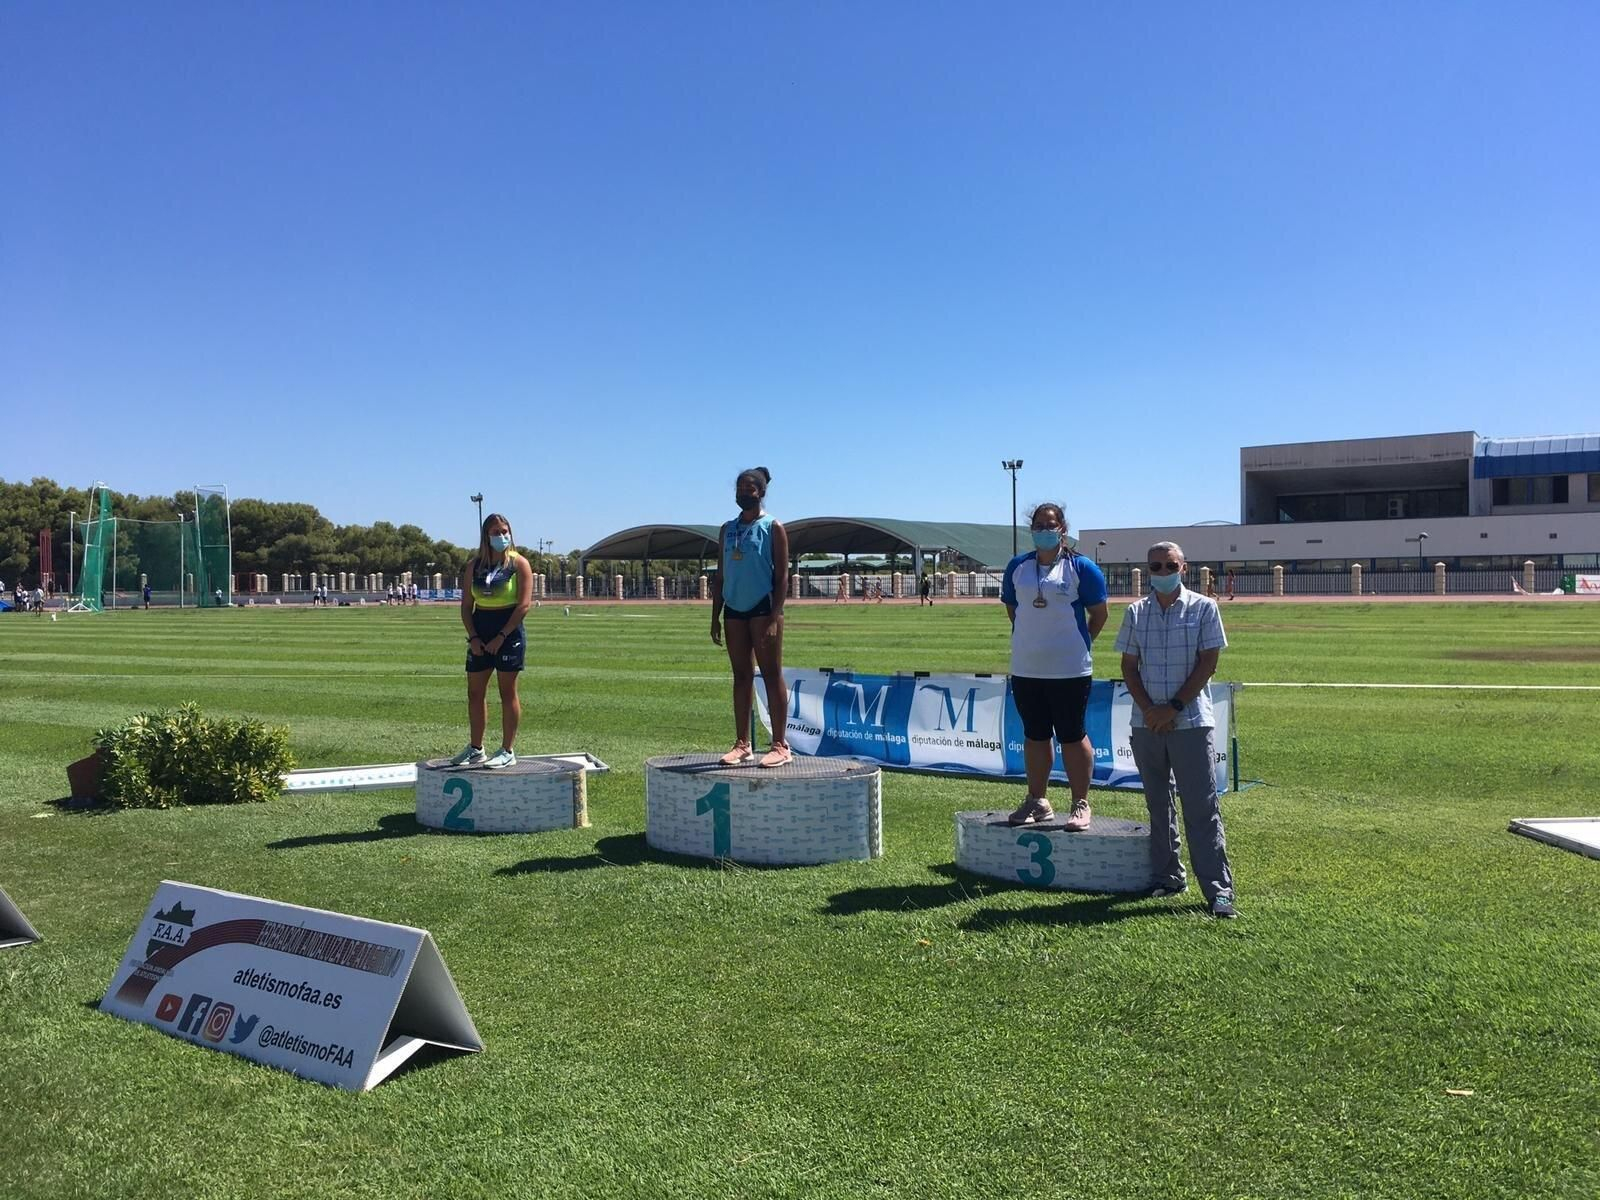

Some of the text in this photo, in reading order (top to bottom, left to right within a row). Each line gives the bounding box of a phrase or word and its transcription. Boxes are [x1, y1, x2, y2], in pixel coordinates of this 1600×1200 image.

[787, 721, 821, 735] málaga
[920, 684, 981, 733] M
[827, 727, 863, 740] diputación
[864, 730, 873, 740] de
[912, 734, 952, 747] diputación
[954, 737, 964, 747] de
[966, 739, 1001, 751] málaga
[442, 777, 475, 830] 2
[696, 782, 731, 857] 1
[1016, 832, 1056, 887] 3
[233, 968, 343, 1009] atletismofaa.es
[258, 1025, 355, 1069] @atletismoFAA
